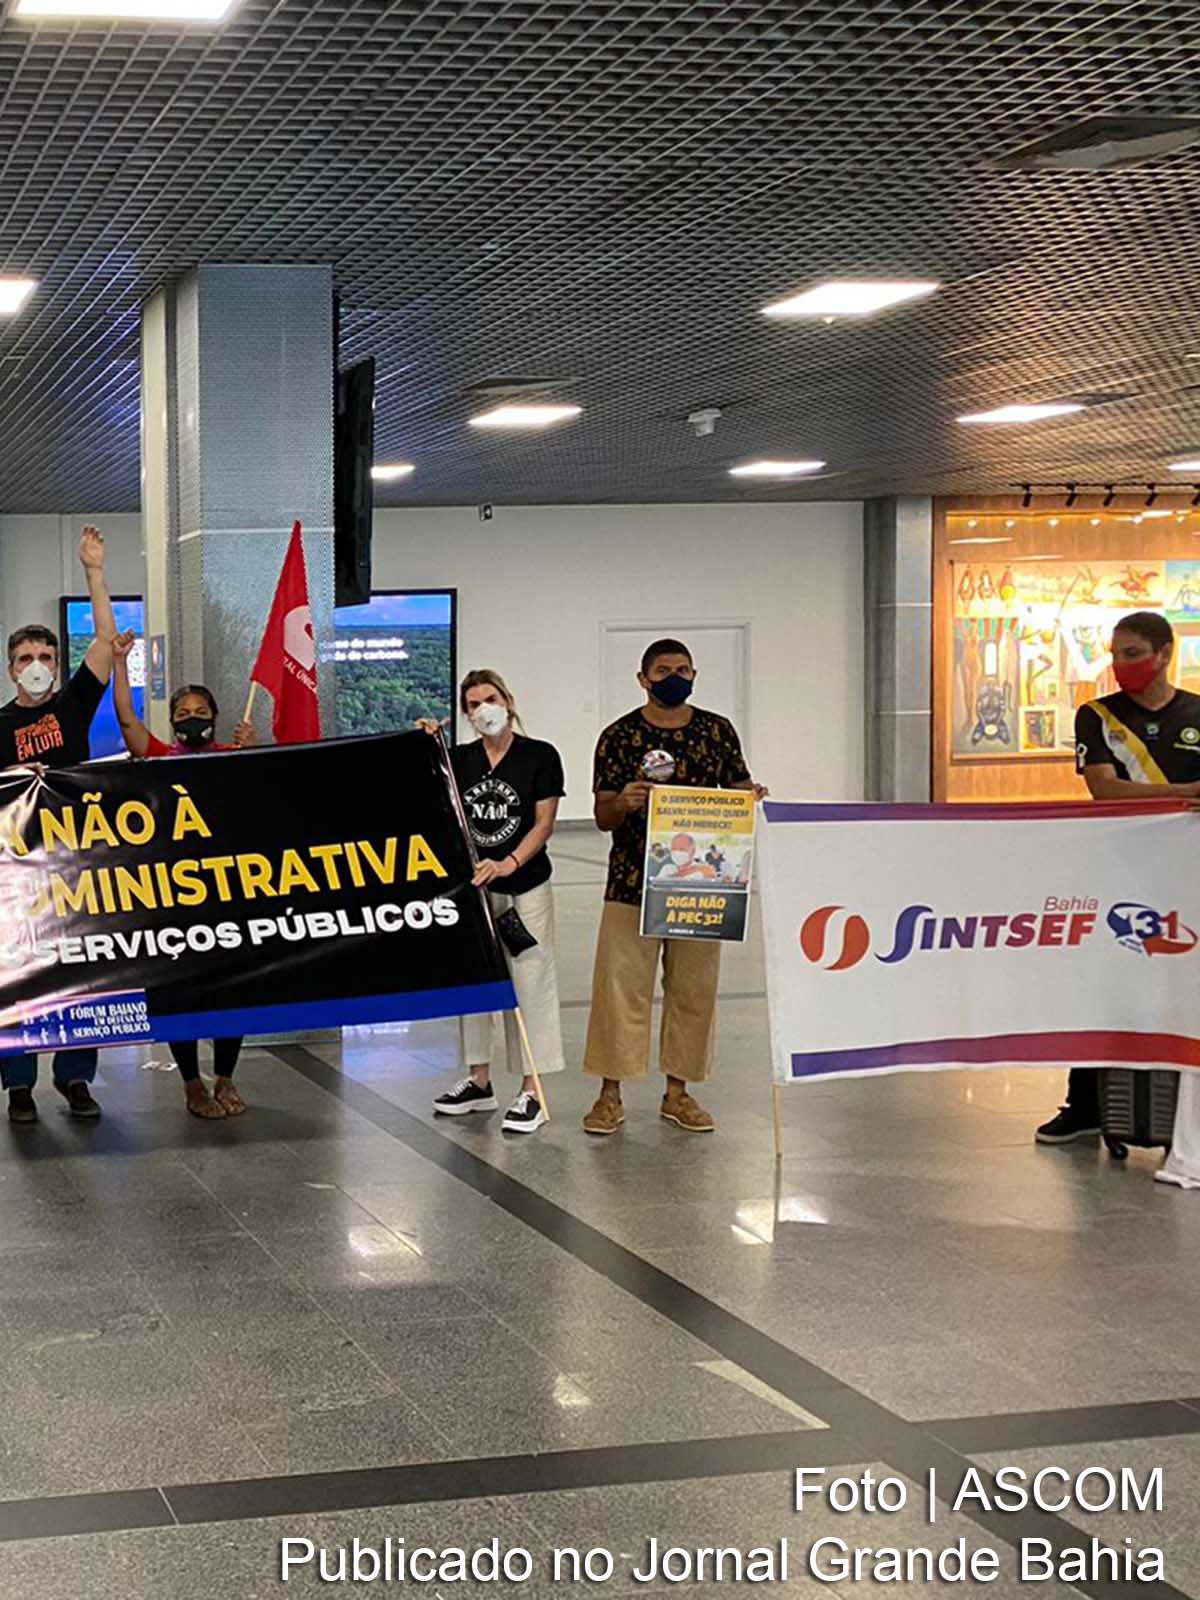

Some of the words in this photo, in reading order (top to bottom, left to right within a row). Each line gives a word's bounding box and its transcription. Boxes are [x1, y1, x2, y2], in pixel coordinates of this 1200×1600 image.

[39, 792, 156, 853] NÃO
[171, 784, 212, 842] À
[472, 801, 508, 820] NÃO!
[666, 896, 696, 909] DIGA
[698, 896, 726, 910] NÃO
[1044, 895, 1098, 912] Bahia
[678, 911, 702, 925] PEC
[703, 911, 723, 926] 32!
[34, 922, 243, 965] SERVIÇOS
[247, 896, 460, 946] PÚBLICOS
[874, 904, 1098, 963] SINTSEF
